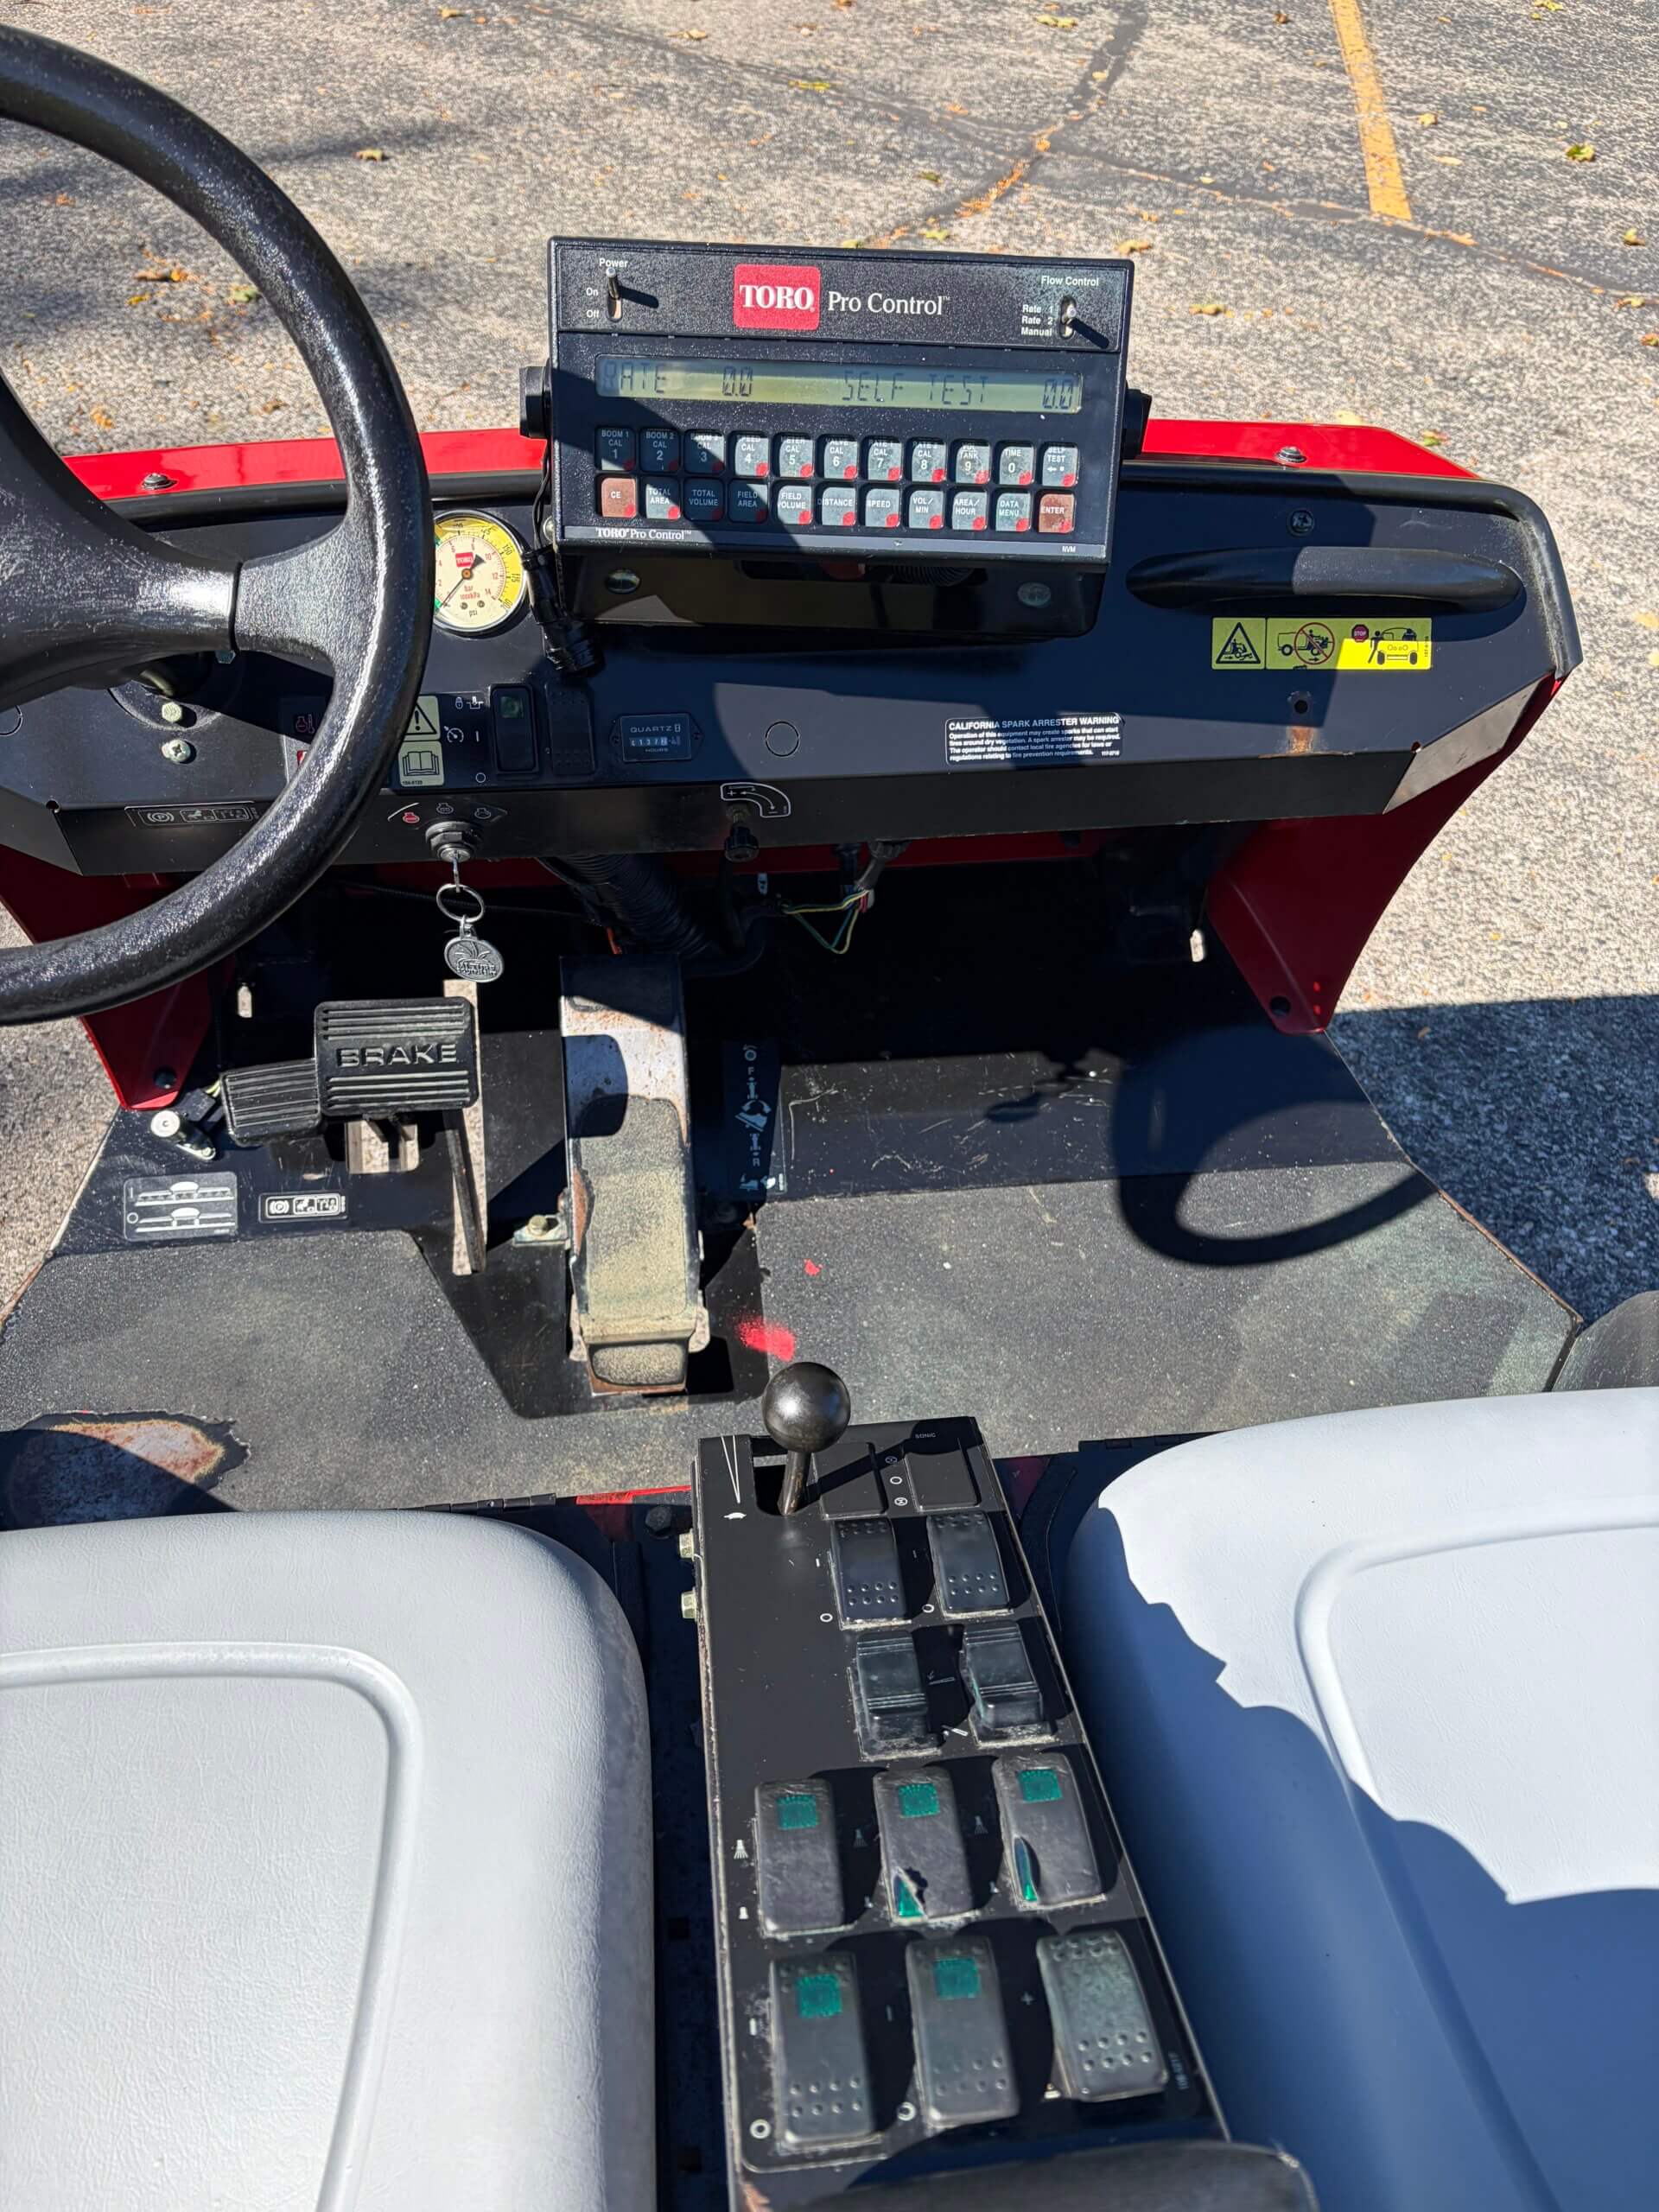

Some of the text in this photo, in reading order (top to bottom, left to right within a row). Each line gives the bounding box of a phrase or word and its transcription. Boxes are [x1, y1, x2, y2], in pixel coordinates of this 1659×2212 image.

[599, 258, 628, 268] Power
[1040, 276, 1099, 286] Flow Control
[740, 284, 815, 312] TORO
[828, 291, 861, 312] Pro
[586, 309, 600, 318] Off
[1022, 304, 1041, 313] Rate
[1021, 315, 1041, 324] Rate
[1020, 327, 1052, 337] Manual
[605, 360, 1073, 409] RATE 0.0 SELF TEST 0.0
[601, 429, 621, 438] BOOM
[613, 449, 619, 459] 1
[657, 450, 664, 461] 2
[700, 452, 708, 462] 3
[744, 454, 752, 464] 4
[1047, 454, 1066, 463] TEST
[789, 454, 796, 465] 5
[833, 456, 840, 467] 6
[877, 458, 884, 468] 7
[920, 460, 927, 469] 8
[964, 461, 972, 471] 9
[1007, 463, 1016, 474] 0
[692, 489, 715, 498] TOTAL
[817, 498, 854, 506] DISTANCE
[867, 499, 891, 508] SPEED
[1040, 505, 1065, 514] ENTER
[630, 528, 646, 538] Pro
[502, 543, 514, 556] 150
[468, 609, 478, 618] psi
[630, 725, 673, 734] QUARTZ
[949, 721, 1000, 731] CALIFORNIA
[1002, 720, 1031, 728] SPARK
[1033, 718, 1077, 727] ARRESTER
[949, 731, 978, 741] Operation
[997, 729, 1028, 739] equipment
[984, 738, 995, 747] dry
[1033, 735, 1050, 744] spark
[987, 744, 1007, 753] should
[1055, 741, 1081, 750] agencies
[336, 1044, 457, 1068] BRAKE
